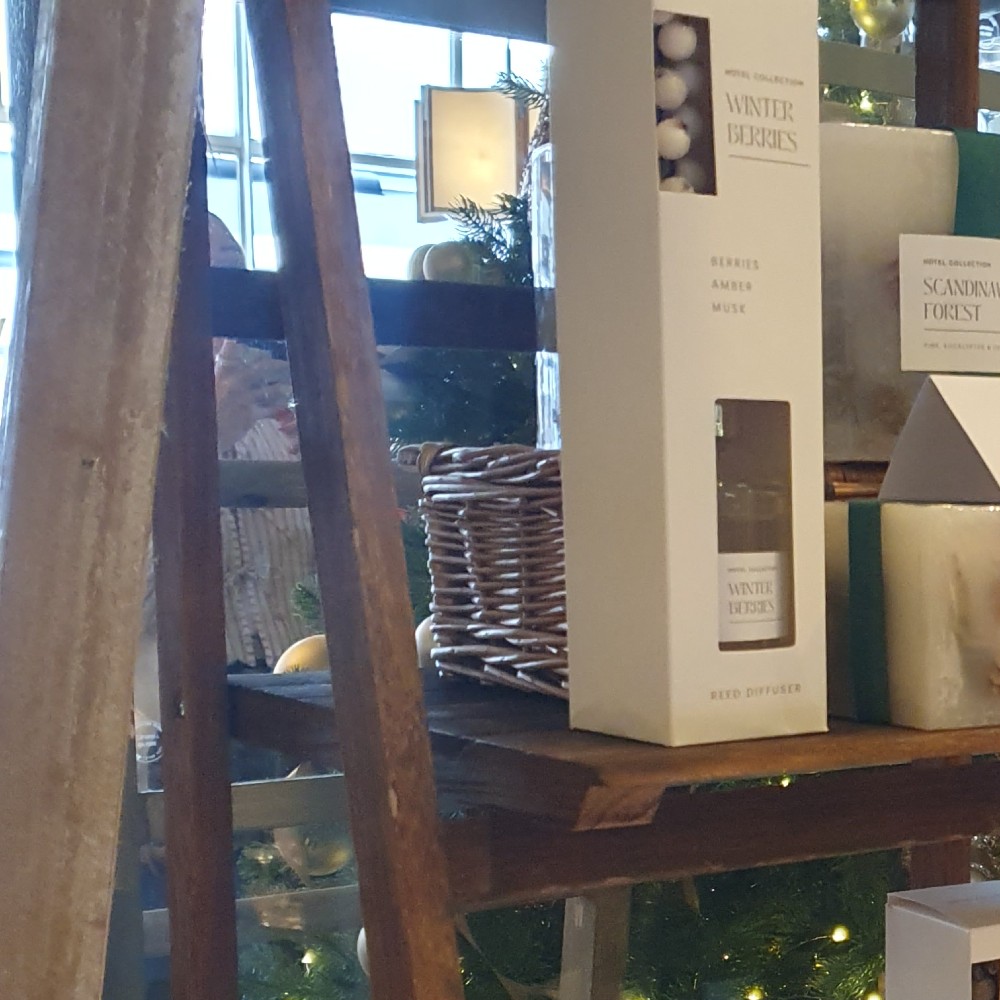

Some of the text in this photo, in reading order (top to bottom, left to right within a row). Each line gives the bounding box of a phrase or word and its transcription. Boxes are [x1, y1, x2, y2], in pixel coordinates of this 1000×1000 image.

[725, 92, 794, 123] WINTER
[727, 123, 798, 152] BERRIES
[711, 255, 760, 271] BERRIES
[923, 258, 946, 267] HOTEL
[711, 279, 753, 292] AMBER
[712, 302, 747, 315] MUSK
[923, 302, 982, 322] FOREST
[746, 683, 802, 698] DIFFUSER
